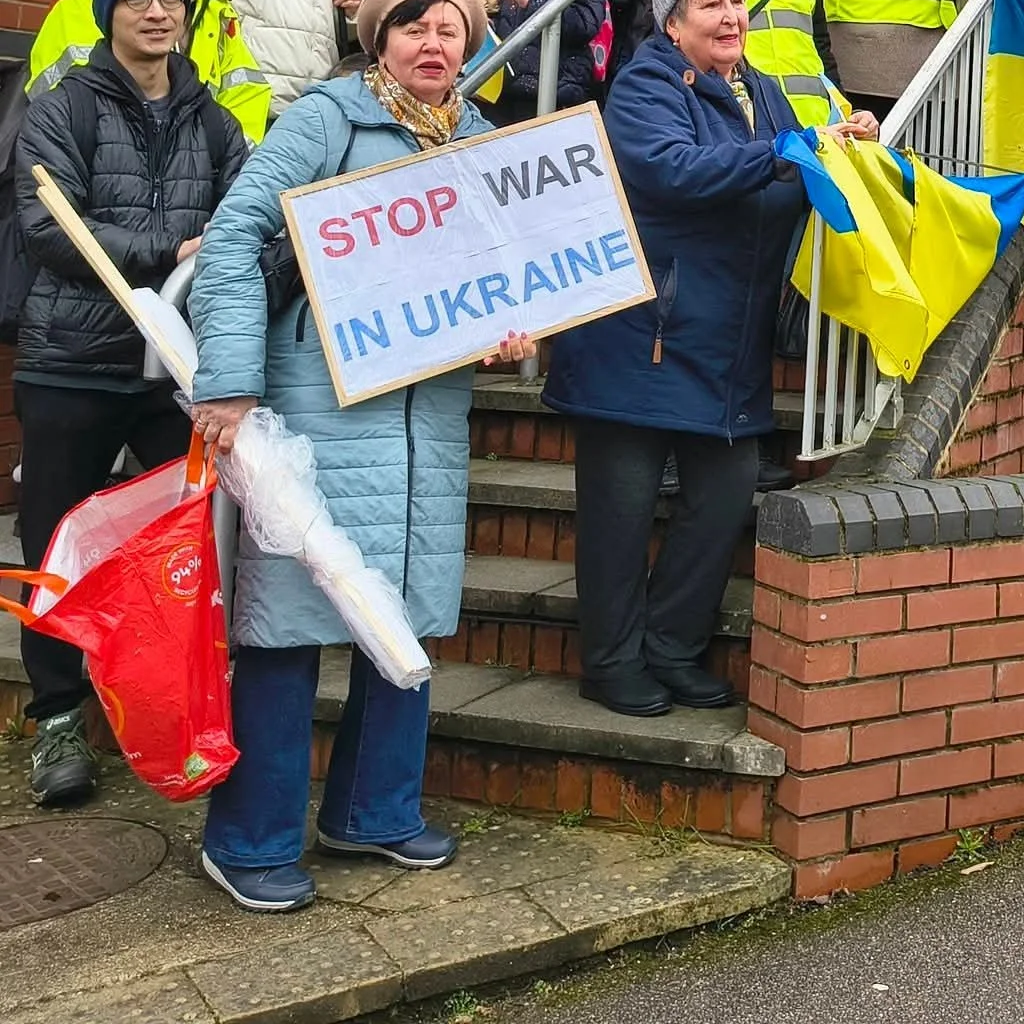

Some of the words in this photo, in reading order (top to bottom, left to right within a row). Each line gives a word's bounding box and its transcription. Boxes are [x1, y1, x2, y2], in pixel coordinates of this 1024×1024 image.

[318, 186, 458, 258] STOP
[482, 143, 604, 207] WAR
[334, 310, 391, 362] IN
[401, 229, 636, 338] UKRAINE
